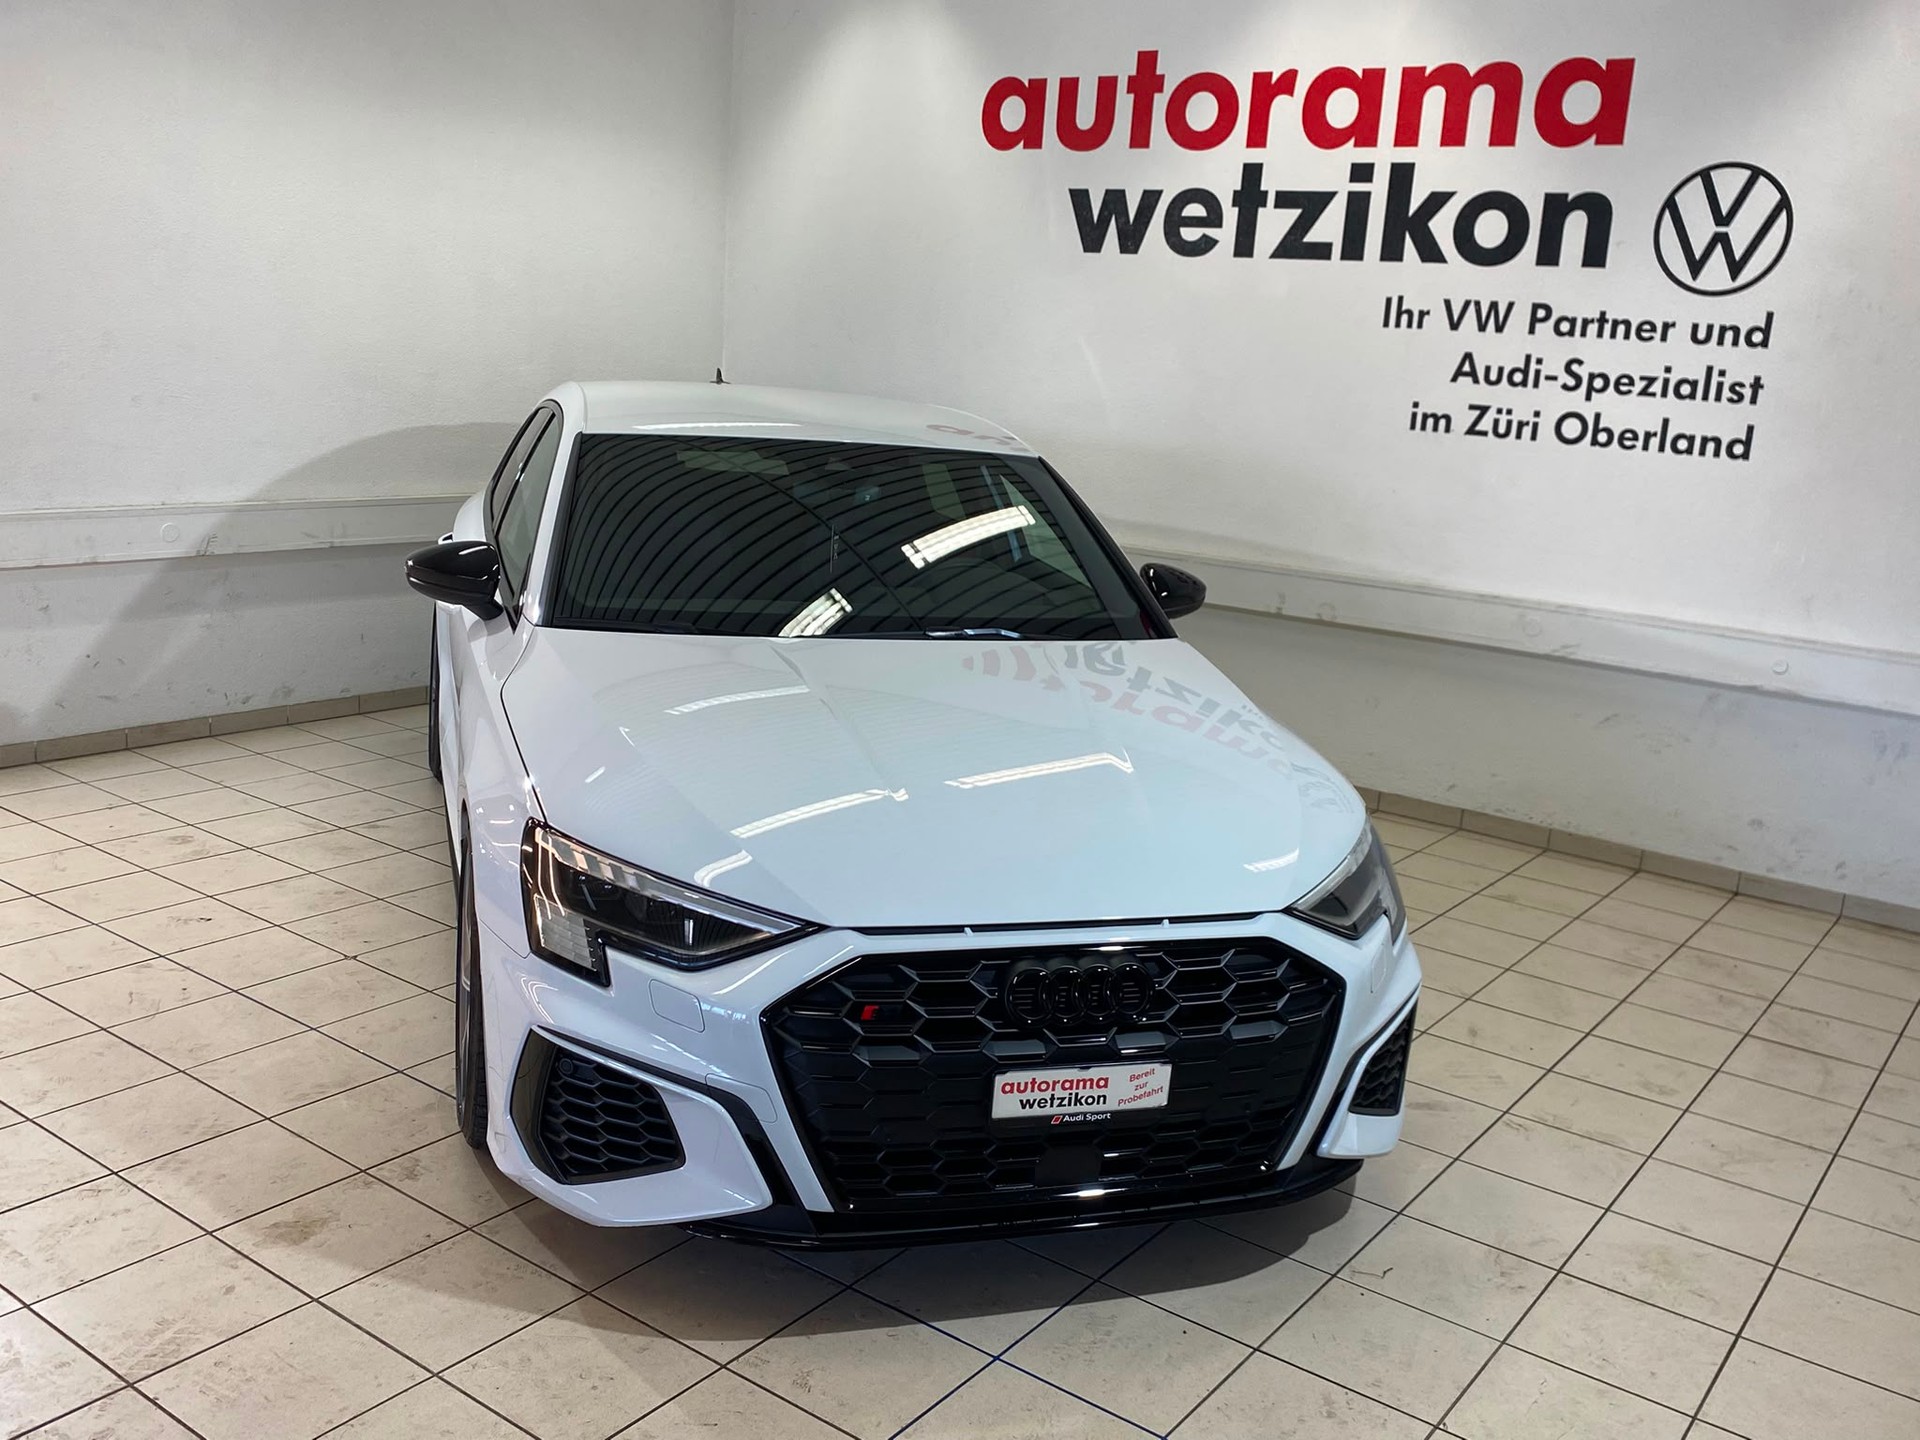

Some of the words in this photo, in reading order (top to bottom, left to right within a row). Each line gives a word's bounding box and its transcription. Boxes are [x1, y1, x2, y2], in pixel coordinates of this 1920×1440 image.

[981, 50, 1635, 151] autorama
[1068, 162, 1613, 268] wetzikon
[1382, 296, 1431, 330] Ihr
[1443, 298, 1515, 334] VW
[1527, 302, 1677, 344] Partner
[1689, 311, 1774, 349] und
[1450, 350, 1765, 406] Audi-Spezialist
[1409, 401, 1453, 434] im
[1464, 404, 1542, 442] Züri
[1553, 411, 1755, 461] Oberland
[1129, 1068, 1155, 1082] Bereit
[1001, 1077, 1109, 1095] autorama
[1118, 1086, 1163, 1107] Probefahrt
[1134, 1081, 1148, 1091] zur
[1019, 1092, 1106, 1110] wetzikon
[1063, 1114, 1084, 1122] Audi
[1086, 1112, 1111, 1122] Sport
